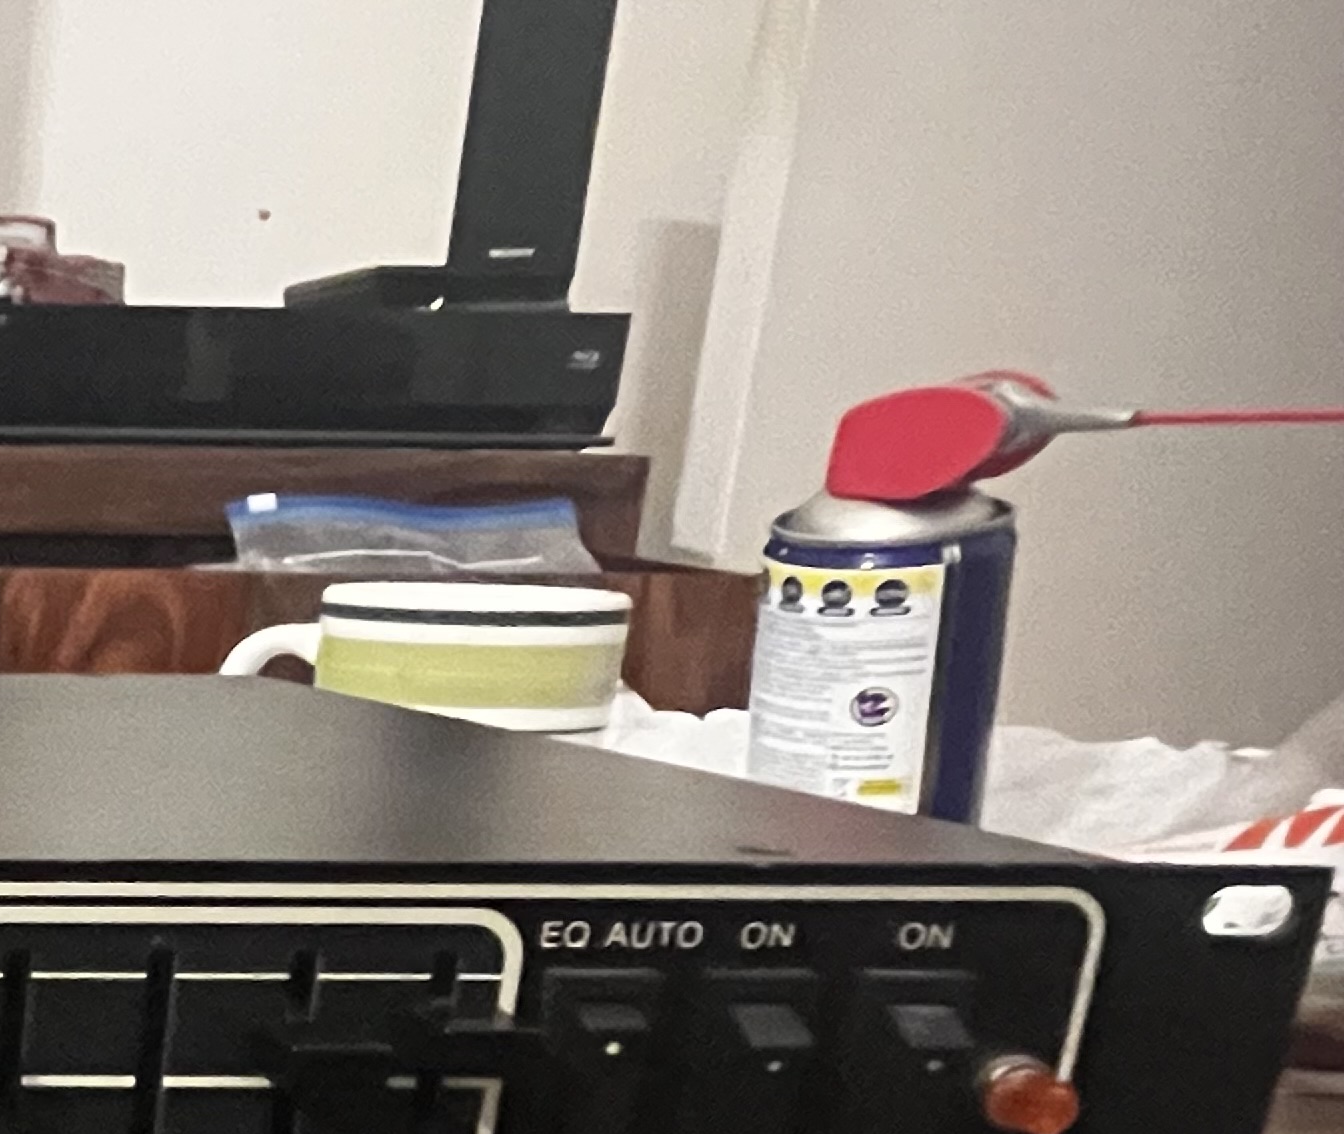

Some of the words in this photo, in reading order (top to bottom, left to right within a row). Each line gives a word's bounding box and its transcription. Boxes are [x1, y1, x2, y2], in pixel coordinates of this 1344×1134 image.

[541, 920, 590, 948] EQ
[604, 920, 704, 948] AUTO
[740, 921, 796, 948] ON
[899, 922, 955, 949] ON
